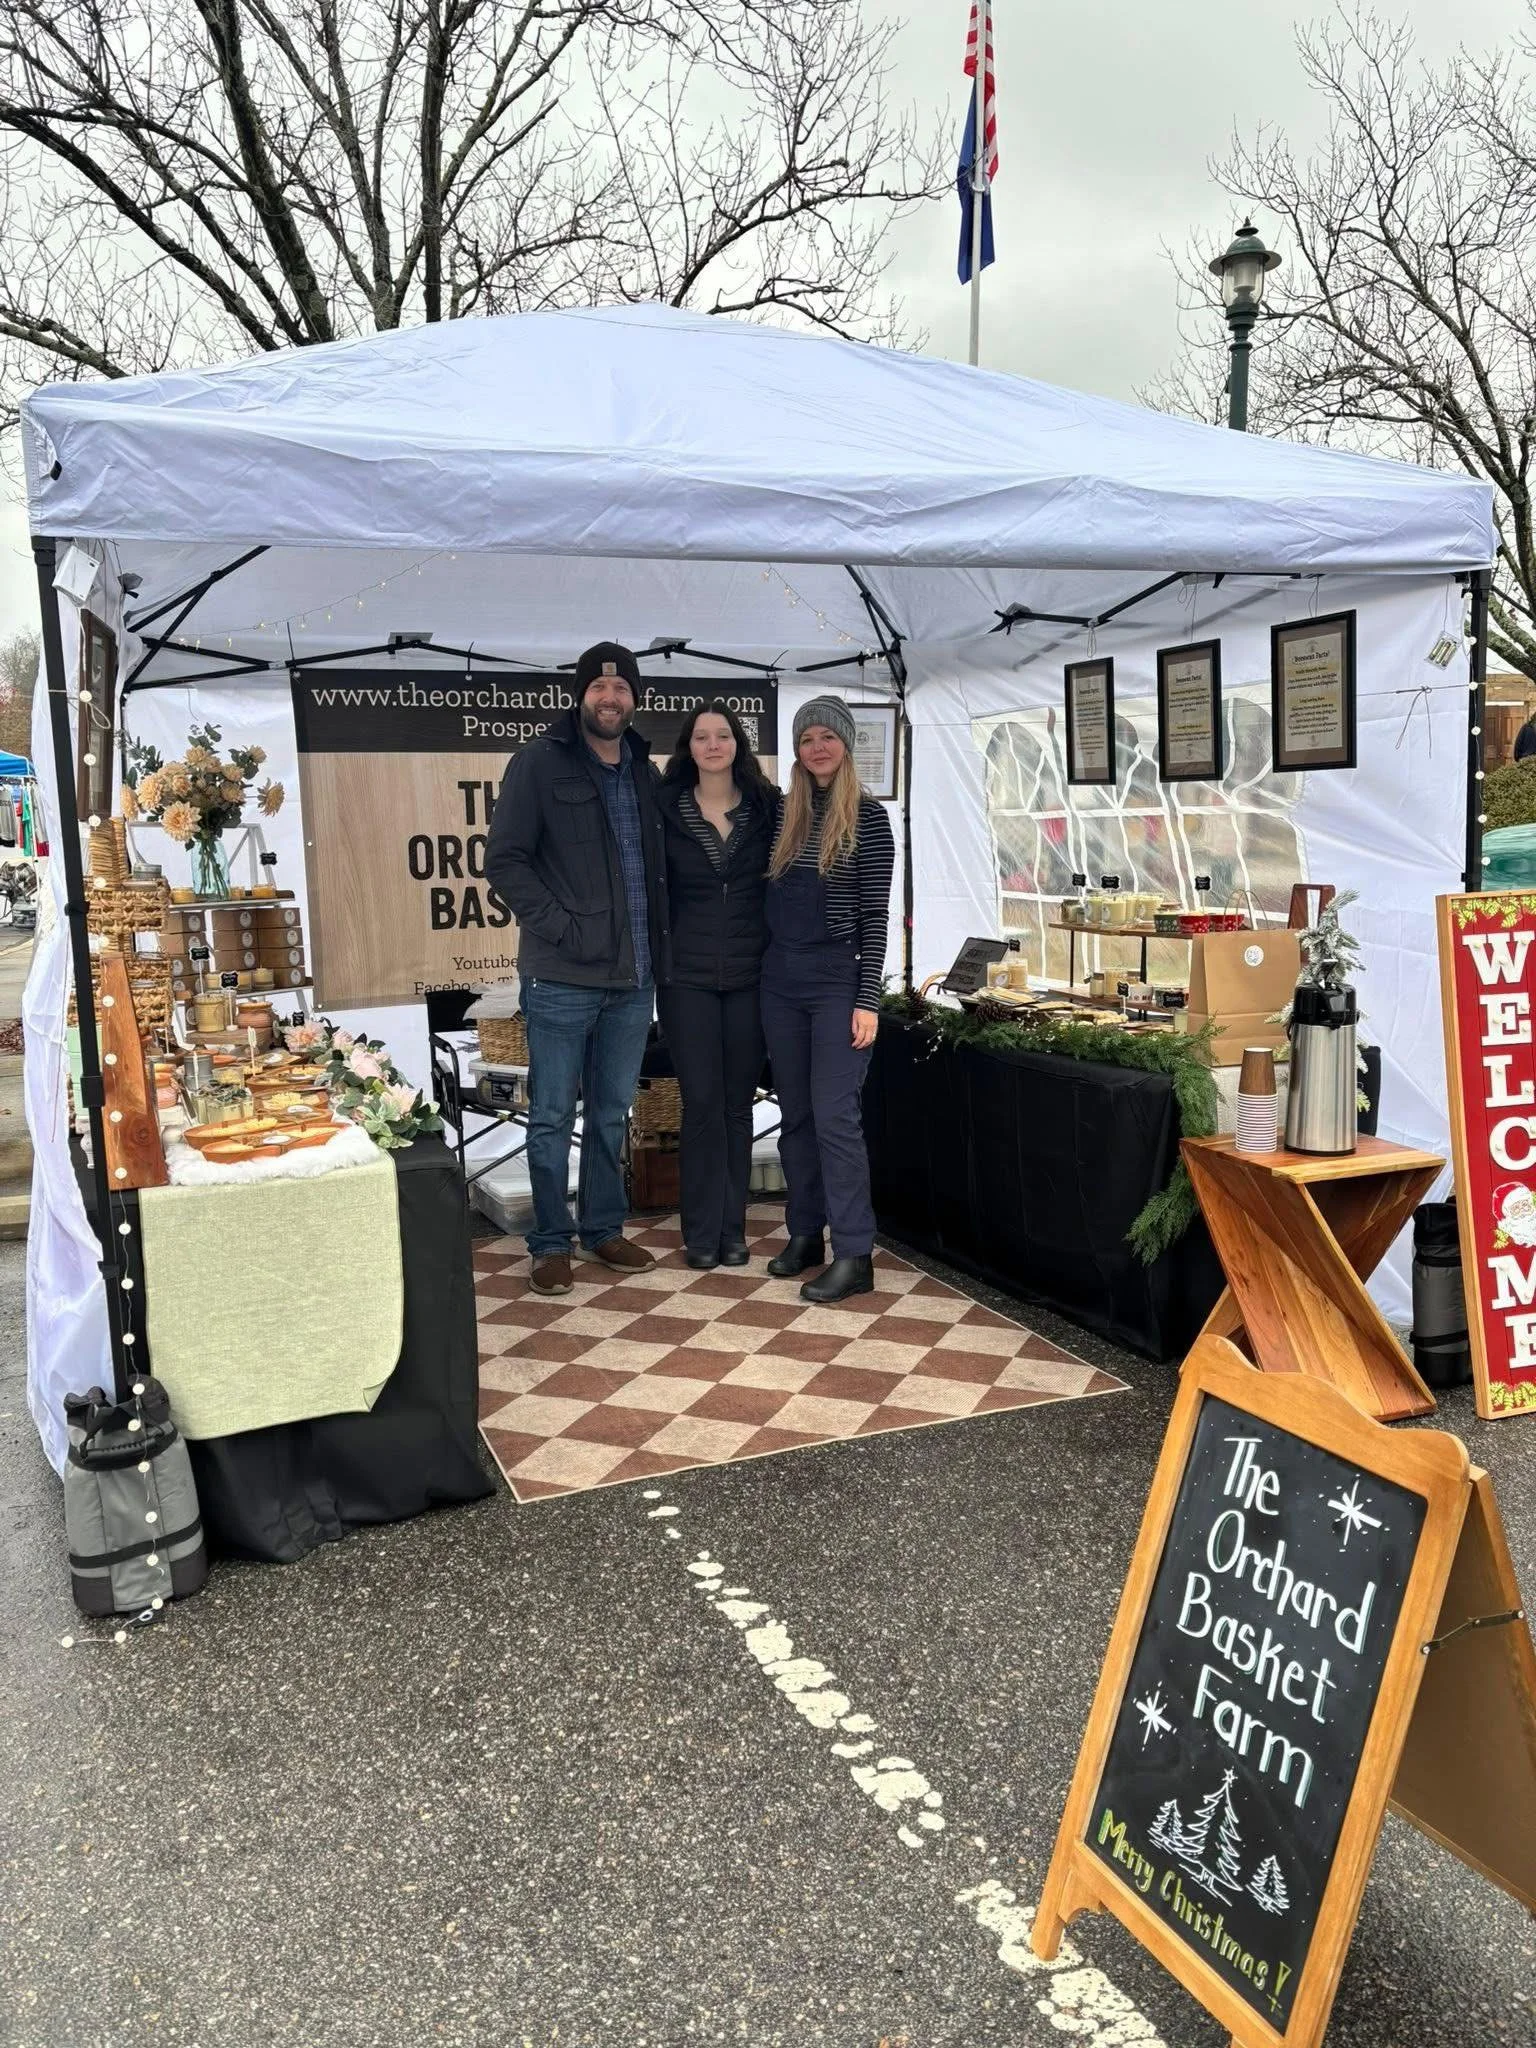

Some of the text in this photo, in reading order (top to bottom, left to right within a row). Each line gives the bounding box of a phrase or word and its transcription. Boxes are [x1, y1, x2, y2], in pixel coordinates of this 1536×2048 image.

[462, 715, 552, 743] Prospe
[458, 781, 503, 825] TH
[408, 834, 488, 880] ORC
[431, 886, 520, 930] BAS
[1224, 1437, 1280, 1515] The
[1207, 1510, 1377, 1654] Orchard
[1176, 1571, 1337, 1724] Basket
[1192, 1664, 1314, 1809] Farm
[1098, 1808, 1155, 1892] Merry
